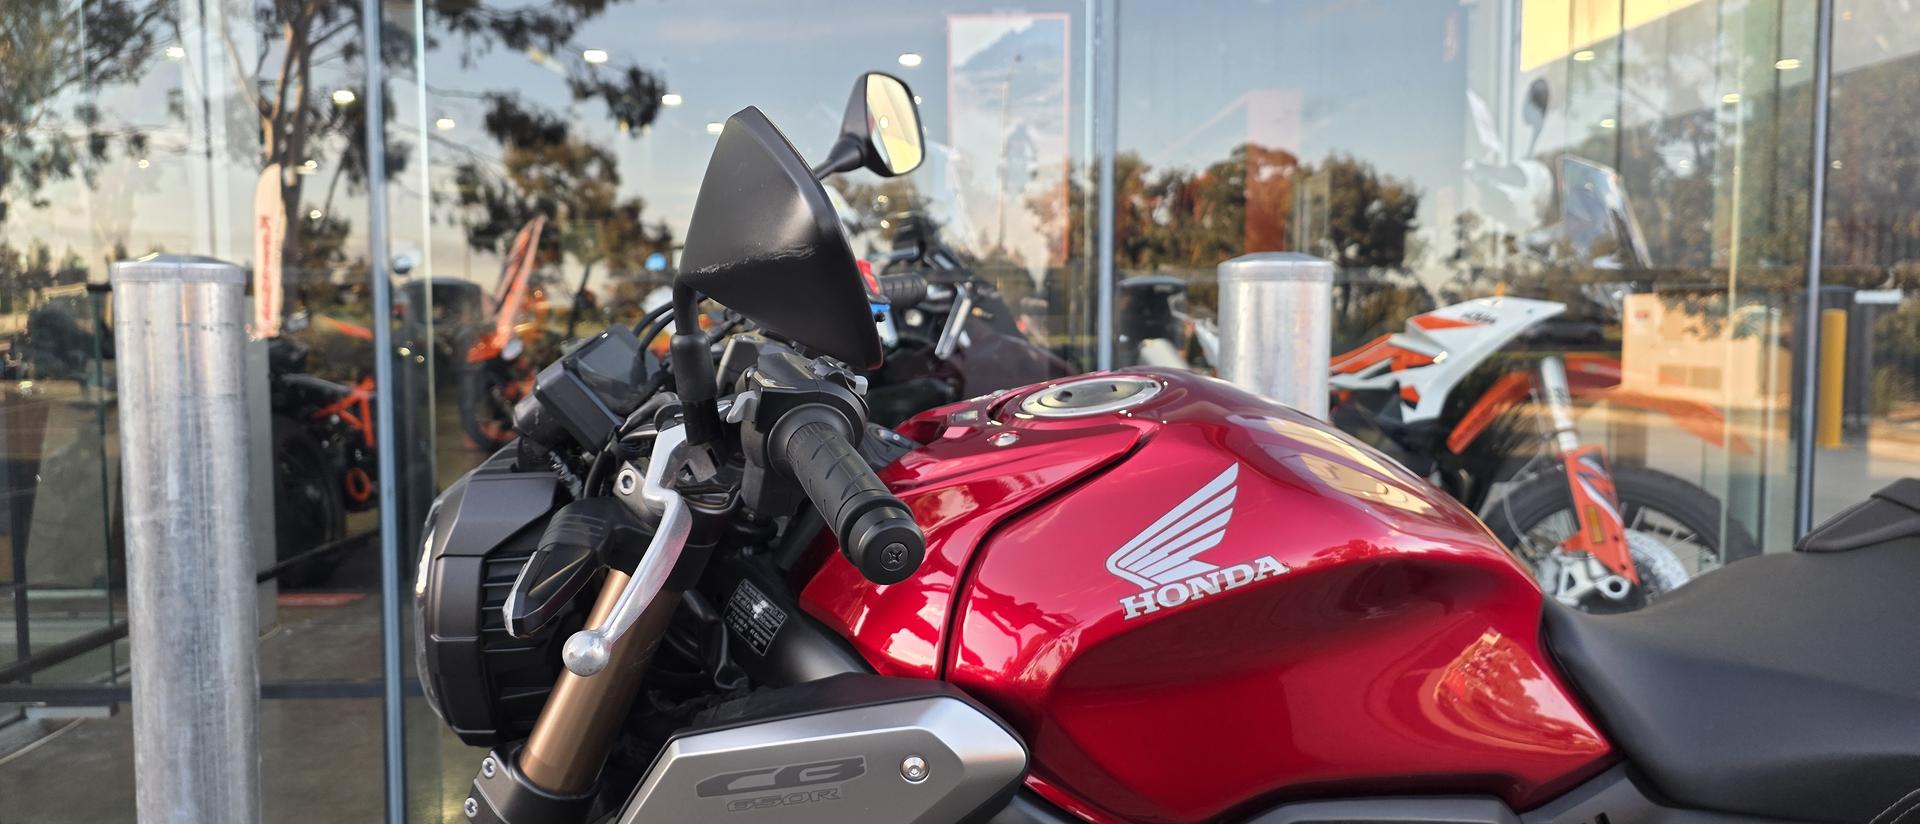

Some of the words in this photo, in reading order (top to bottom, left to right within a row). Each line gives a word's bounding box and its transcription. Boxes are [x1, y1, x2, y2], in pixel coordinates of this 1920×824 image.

[1119, 555, 1290, 621] HONDA
[696, 755, 867, 799] CB
[726, 787, 842, 813] 650R
